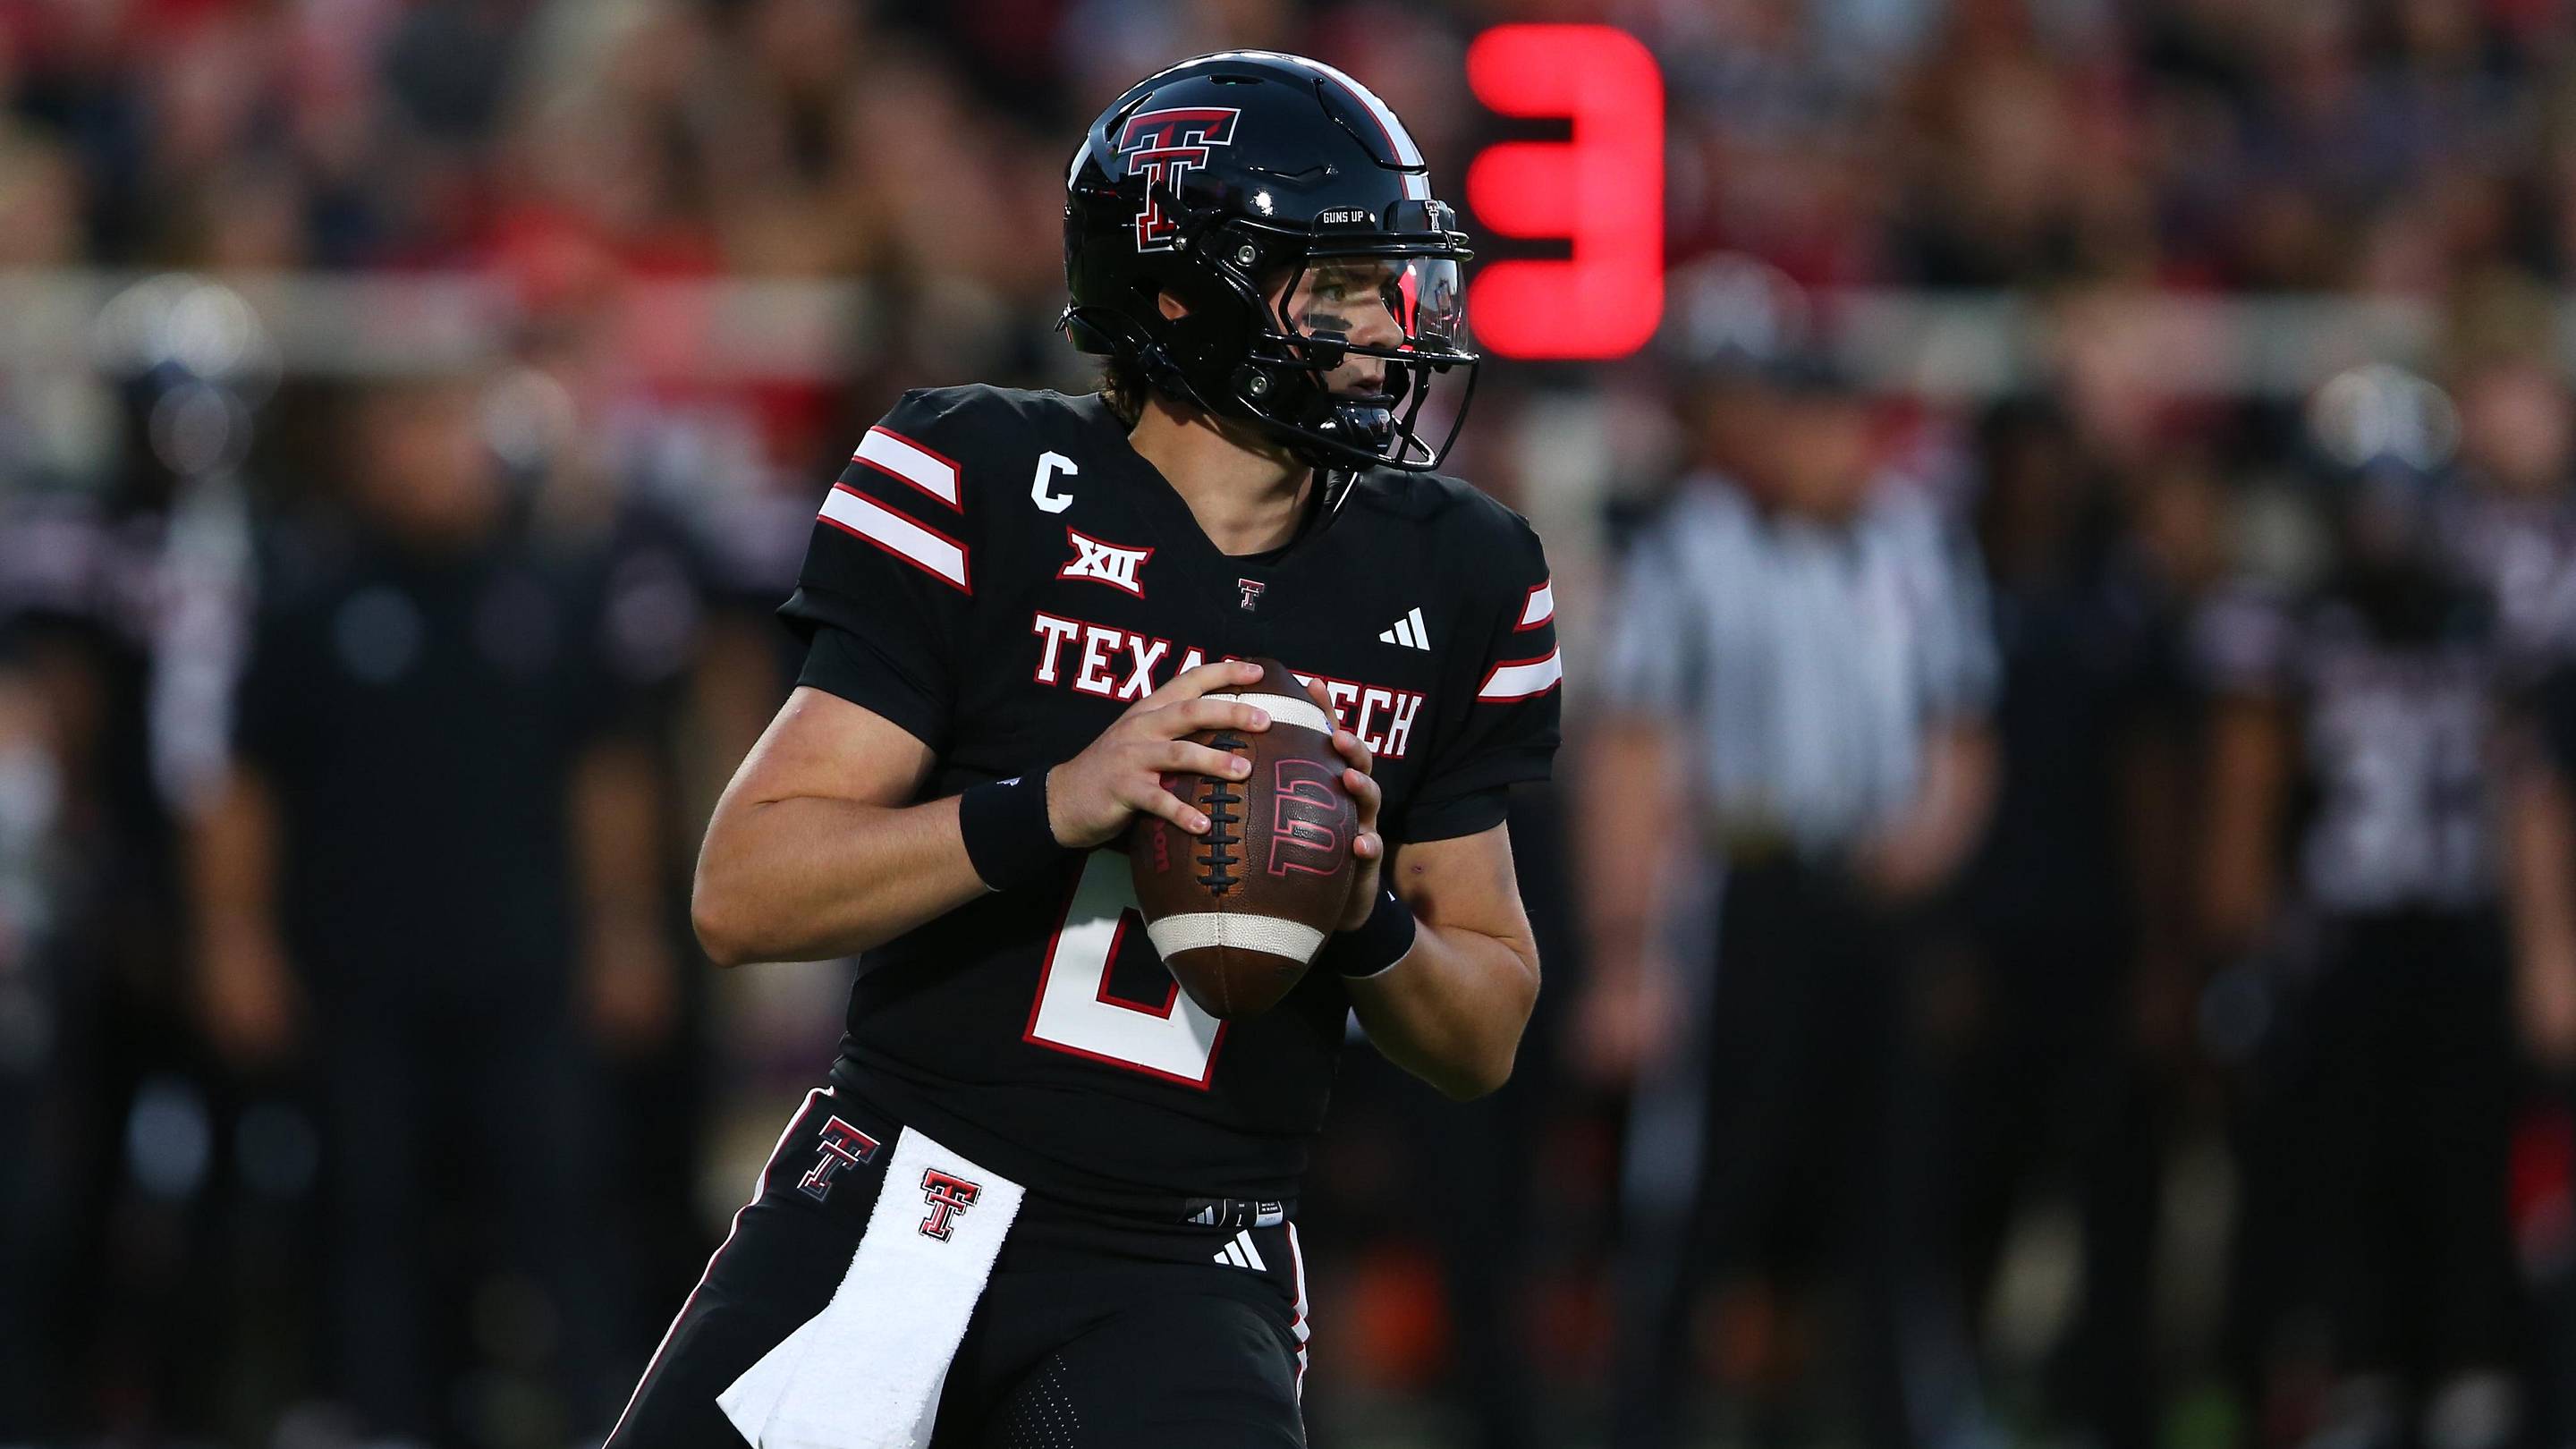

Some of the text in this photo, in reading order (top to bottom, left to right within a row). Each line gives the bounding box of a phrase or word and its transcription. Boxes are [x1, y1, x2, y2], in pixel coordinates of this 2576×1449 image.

[1323, 210, 1364, 224] GUNS UP
[1467, 24, 1665, 359] 3
[1031, 450, 1078, 514] C
[1057, 526, 1154, 598] XII
[1032, 612, 1426, 758] TEX ECH
